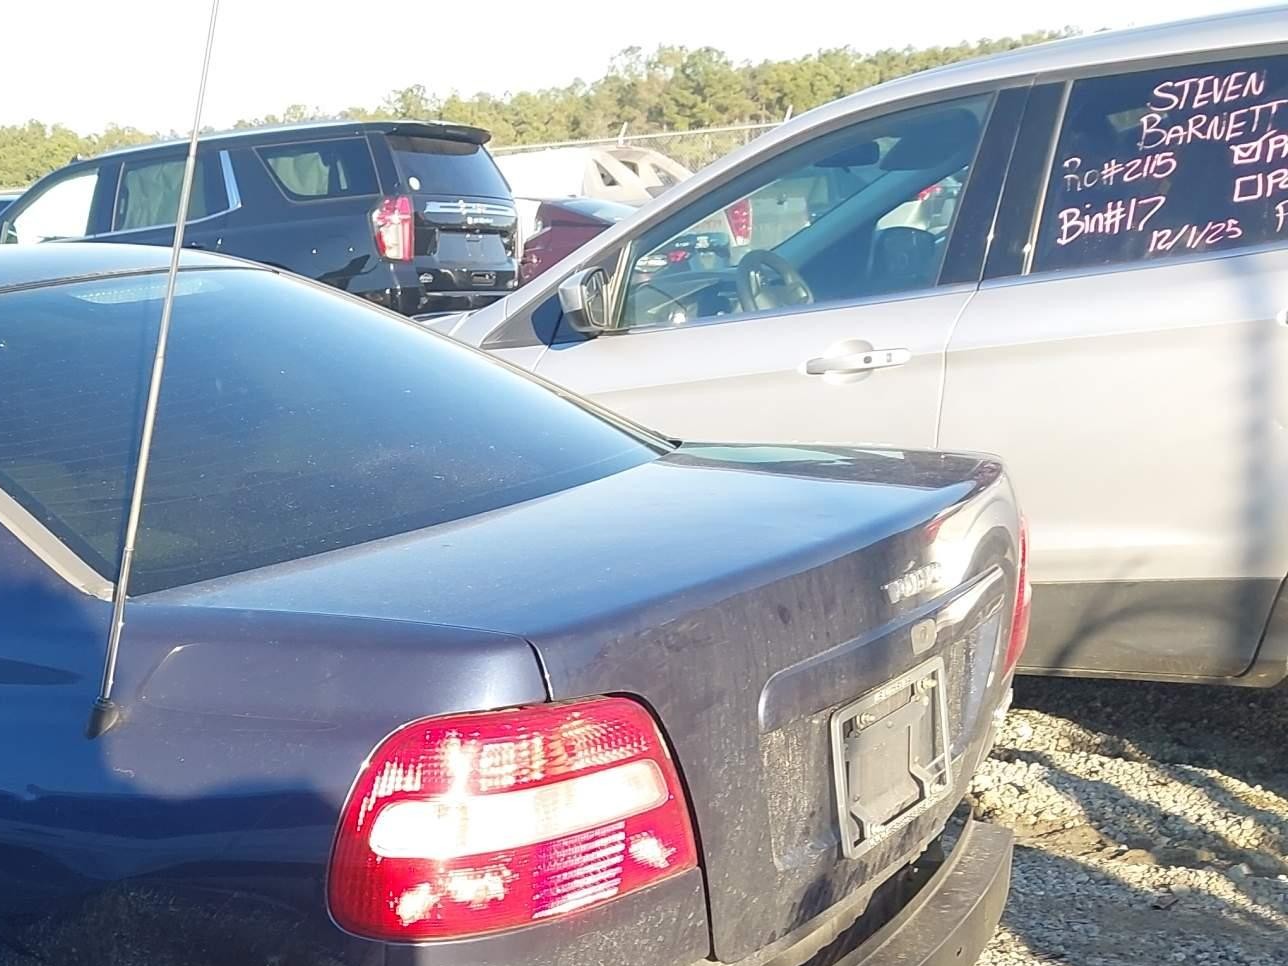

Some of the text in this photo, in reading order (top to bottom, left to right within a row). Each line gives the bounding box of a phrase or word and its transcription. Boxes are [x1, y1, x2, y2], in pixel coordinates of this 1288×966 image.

[1146, 70, 1266, 112] STEVEN
[1137, 100, 1288, 150] BARNETT
[1148, 218, 1243, 253] 12/1/25
